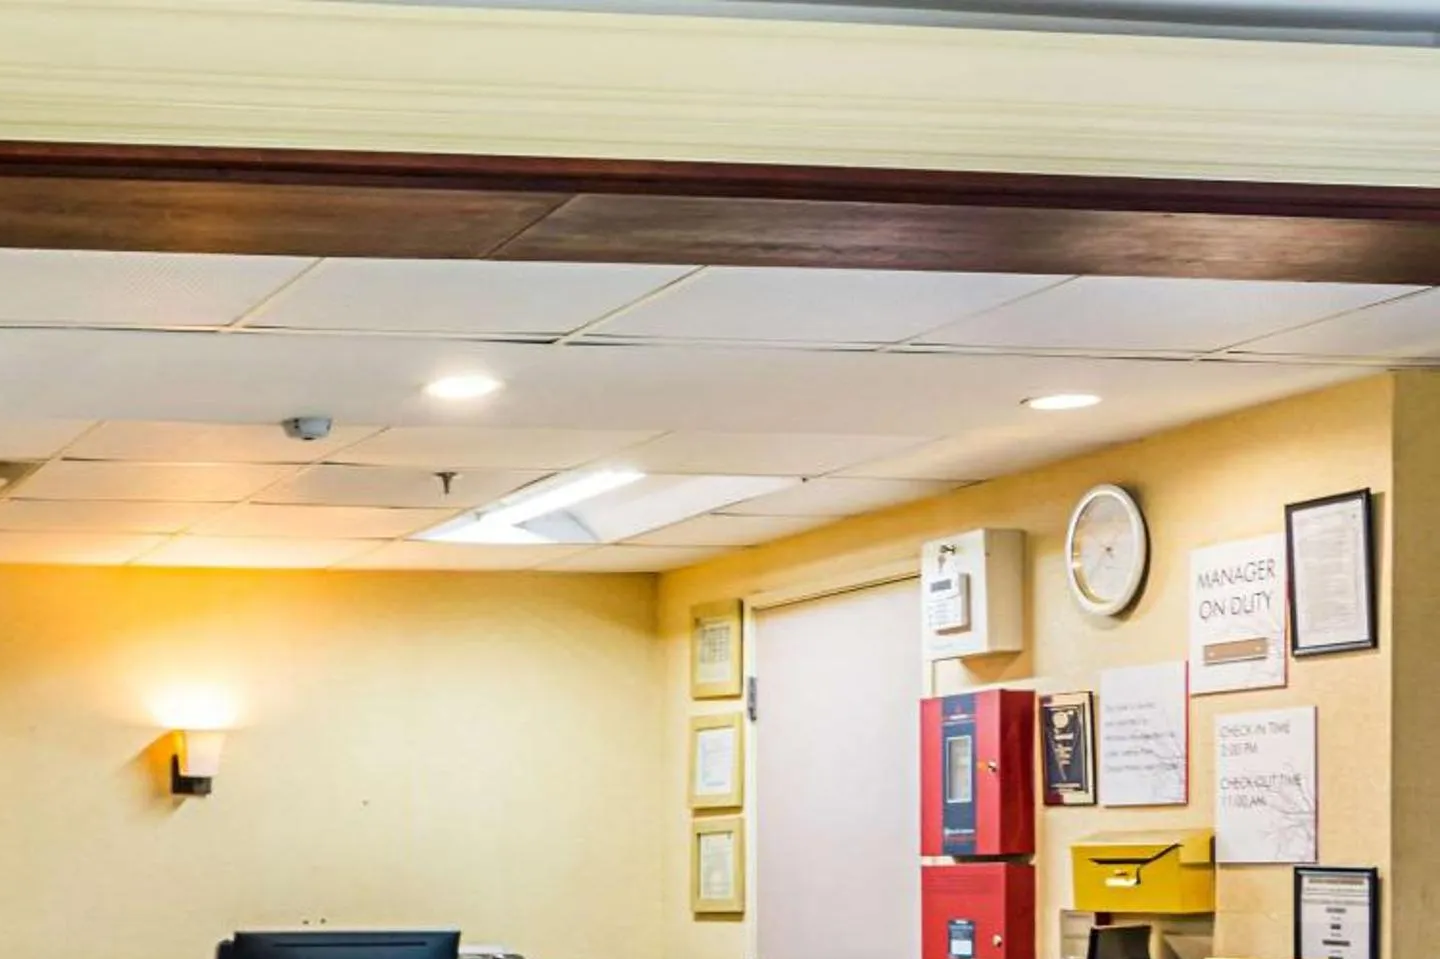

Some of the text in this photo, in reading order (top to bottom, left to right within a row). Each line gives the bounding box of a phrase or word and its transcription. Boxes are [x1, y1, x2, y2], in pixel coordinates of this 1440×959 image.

[1198, 557, 1275, 588] MANAGER
[1199, 588, 1273, 621] ON DUTY
[1220, 724, 1251, 738] CHECK
